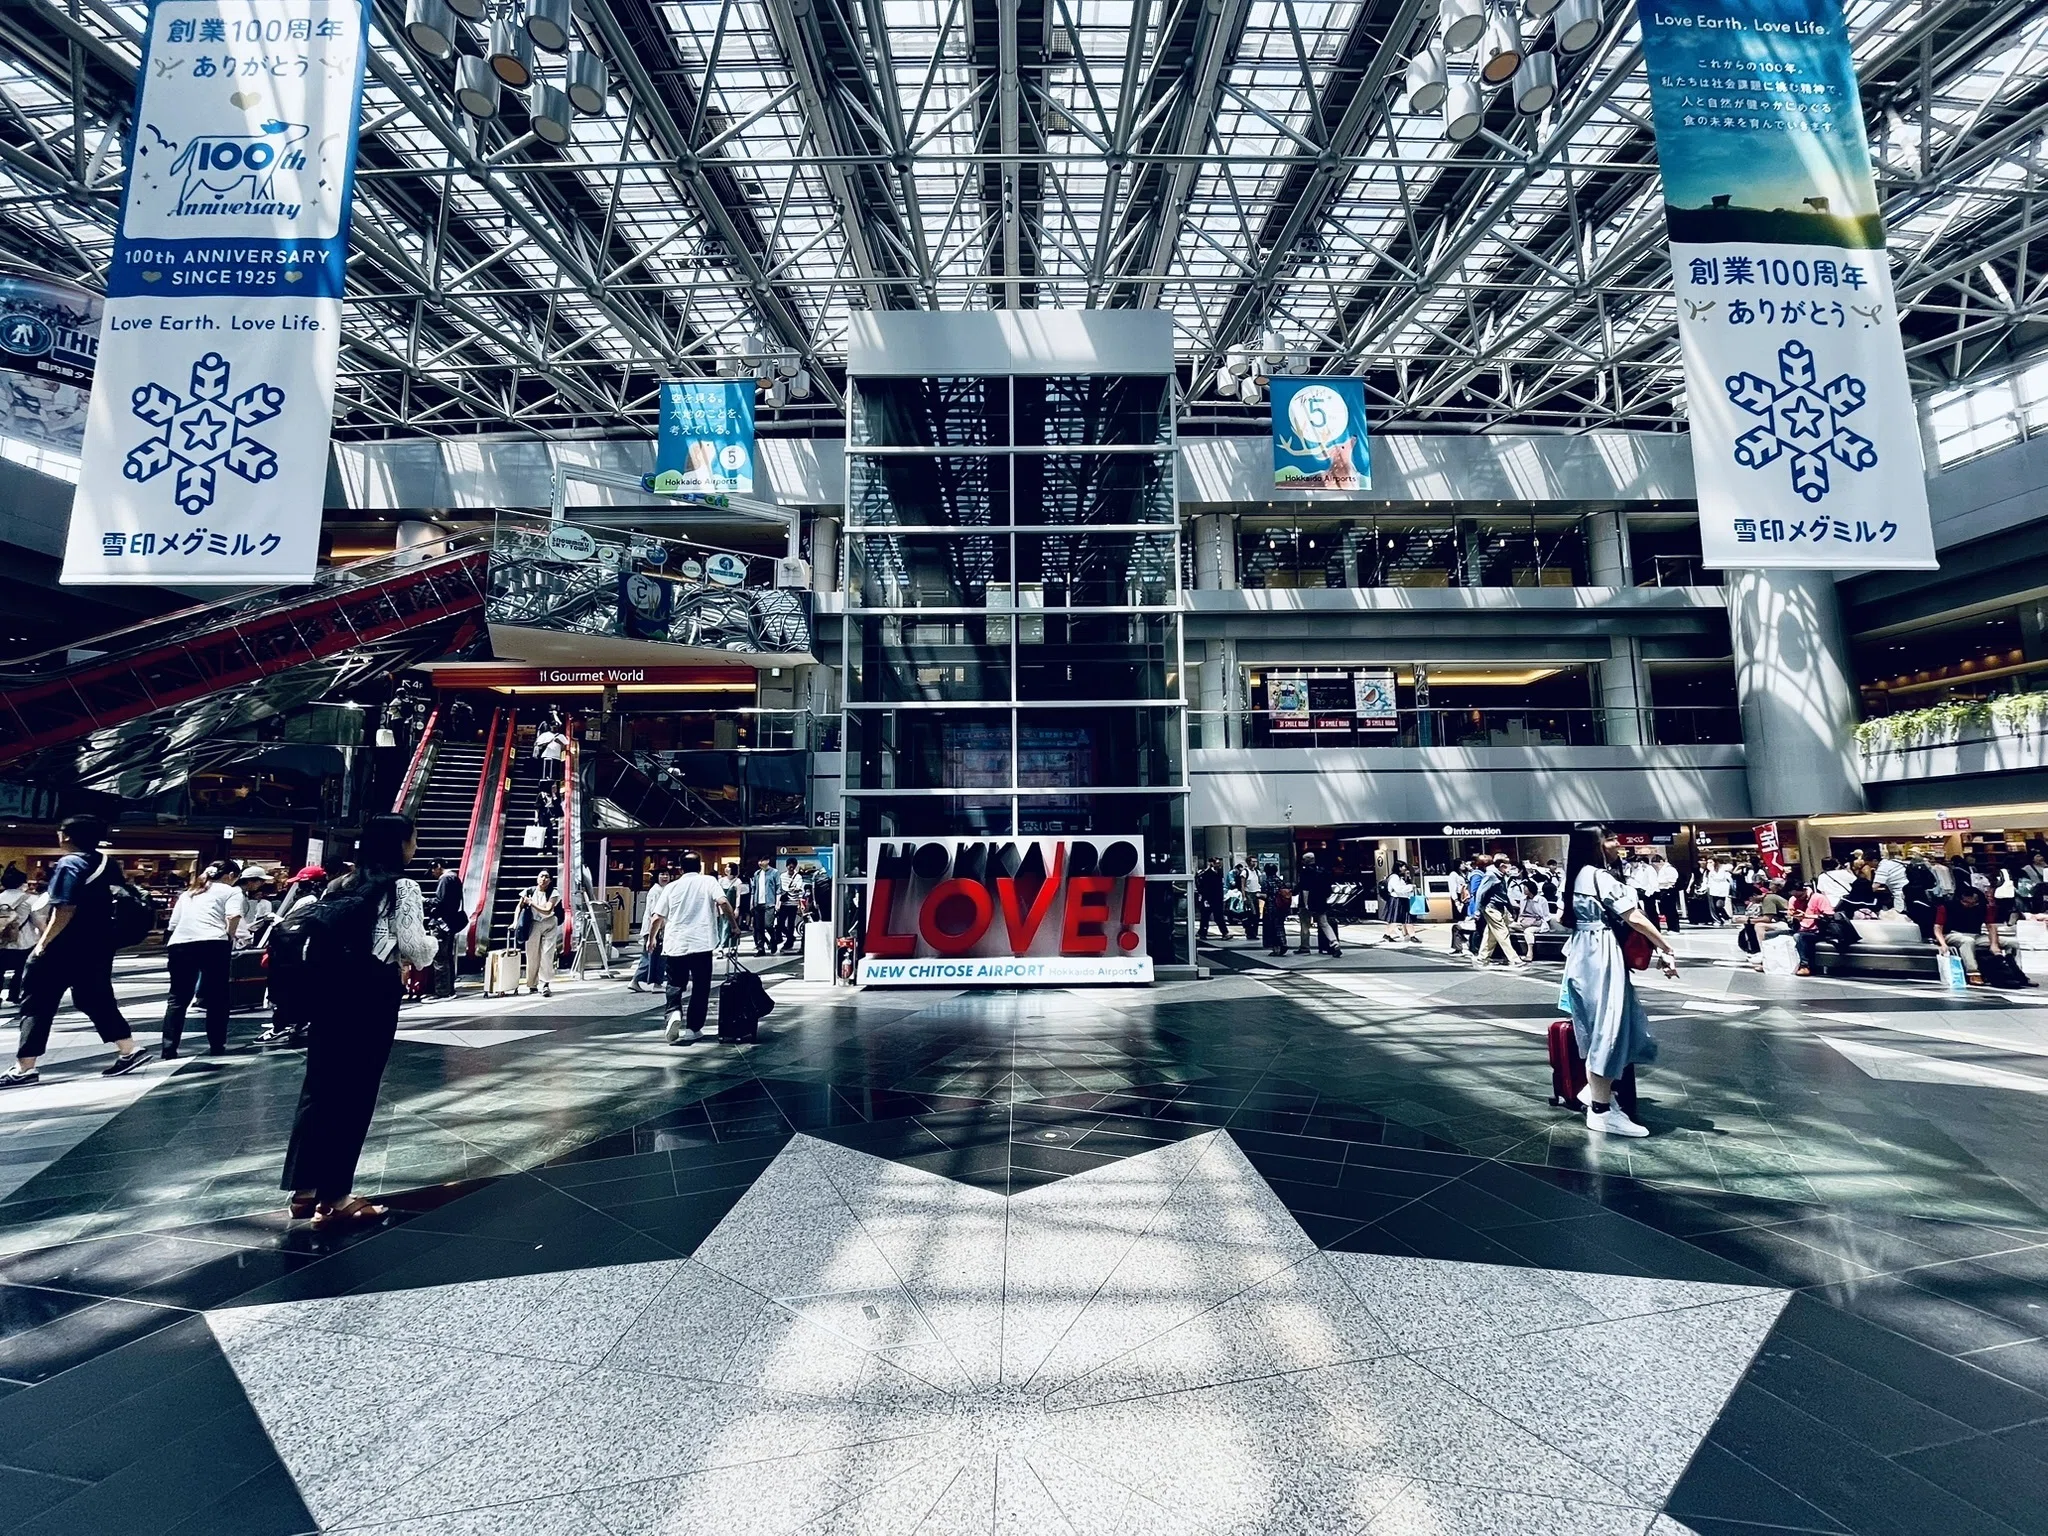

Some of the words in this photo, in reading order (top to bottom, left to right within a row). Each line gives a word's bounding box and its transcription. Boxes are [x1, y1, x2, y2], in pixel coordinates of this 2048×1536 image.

[167, 17, 344, 44] 創業100周年
[1654, 13, 1693, 28] Love
[1696, 15, 1748, 31] Earth.
[1754, 18, 1791, 33] Love
[1795, 21, 1831, 36] Life.
[193, 54, 309, 78] ありがとう
[1697, 59, 1803, 74] これからの100年。
[167, 199, 301, 219] Anniversary
[125, 250, 175, 264] 100th
[183, 250, 330, 264] ANNIVERSARY
[172, 270, 231, 285] SINCE
[235, 271, 277, 285] 1925
[1688, 256, 1868, 291] 創業100周年
[1728, 298, 1845, 328] ありがとう
[111, 316, 153, 331] Love
[160, 315, 221, 330] Earth.
[231, 316, 276, 331] Love
[282, 315, 326, 331] Life.
[1308, 398, 1327, 428] 5
[669, 424, 731, 436] 考えている。
[728, 450, 736, 464] 5
[665, 478, 702, 486] Hokkaido
[1324, 475, 1357, 484] Airports
[1733, 515, 1898, 543] 雪印メグミルク
[102, 527, 281, 556] 雪印メグミルク
[550, 670, 605, 682] Gourmet
[607, 669, 644, 681] World
[1453, 827, 1502, 835] Information
[863, 876, 1146, 957] LOVE!
[866, 966, 905, 978] NEW
[908, 965, 973, 978] CHITOSE
[977, 964, 1044, 978] AIRPORT
[1048, 967, 1095, 976] Hokkaido
[1097, 967, 1138, 977] Airports
